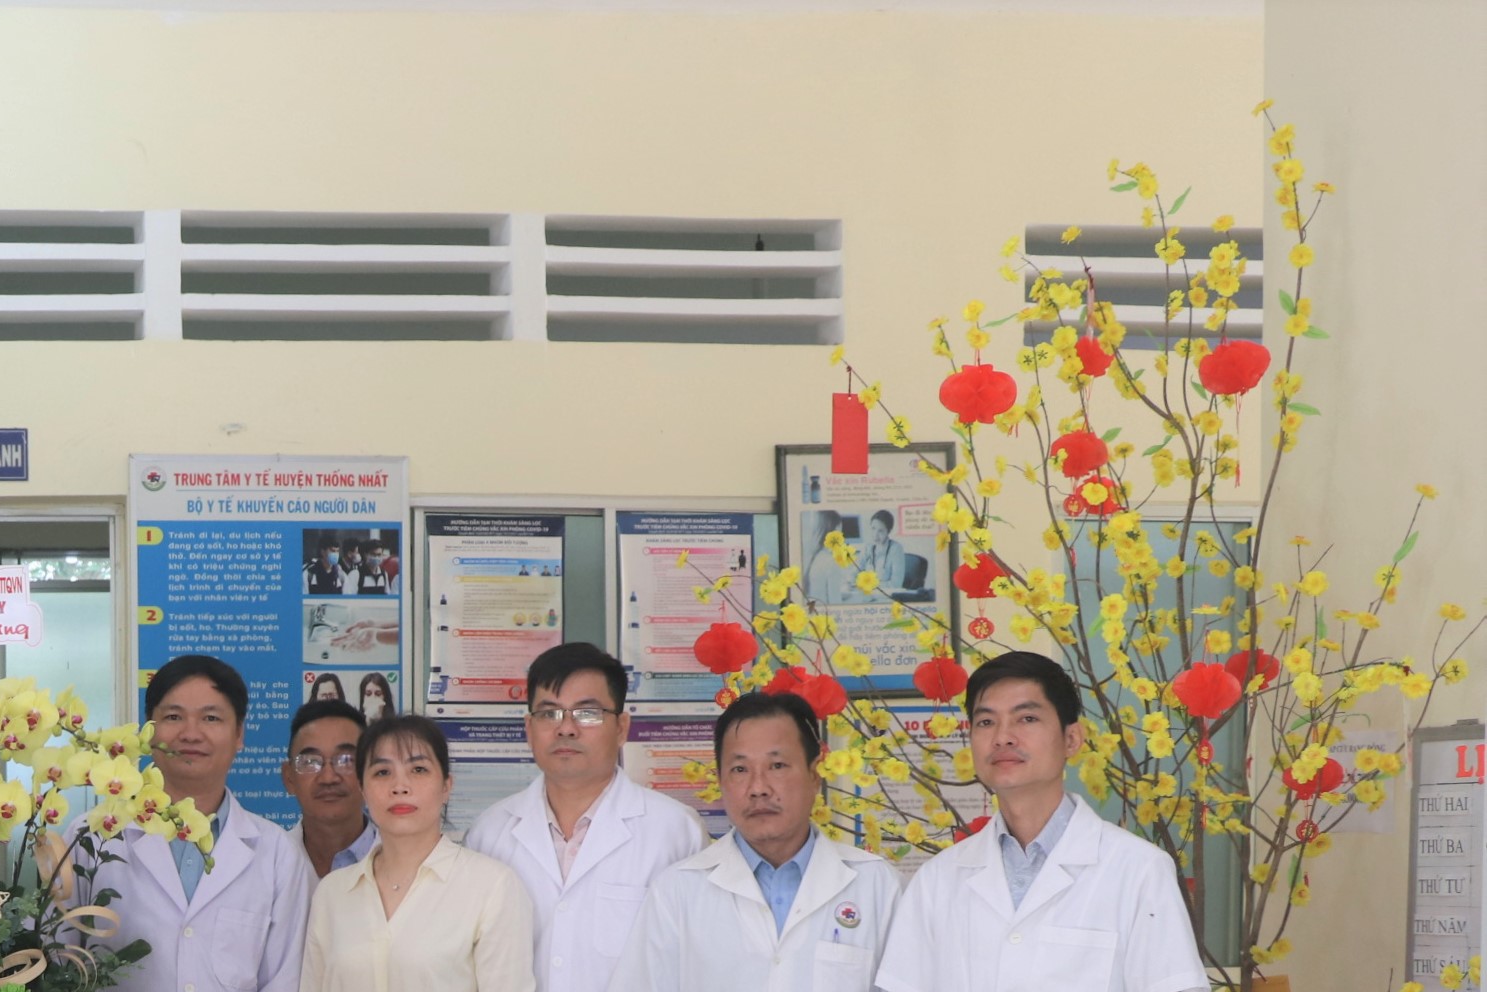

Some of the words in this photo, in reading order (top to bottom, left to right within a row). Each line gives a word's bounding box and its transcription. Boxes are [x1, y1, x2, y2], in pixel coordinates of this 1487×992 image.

[174, 473, 212, 486] TRUNG
[216, 470, 240, 486] TÂM
[245, 473, 251, 486] Y
[255, 468, 271, 486] TẾ
[274, 471, 312, 489] HUYỆN
[317, 469, 355, 487] THỐNG
[359, 469, 388, 487] NHẤT
[187, 497, 202, 516] BỘ
[208, 500, 214, 513] Y
[218, 495, 234, 513] TẾ
[237, 496, 283, 513] KHUYẾN
[287, 496, 310, 514] CÁO
[314, 497, 349, 514] NGƯỜI
[352, 497, 376, 513] DÂN
[146, 530, 151, 542] 1
[146, 610, 156, 621] 2
[904, 721, 919, 731] 10
[1419, 793, 1443, 812] THỨ
[1445, 796, 1470, 812] HAI
[1420, 835, 1443, 854] THỨ
[1446, 839, 1463, 853] BA
[1419, 874, 1443, 894] THỨ
[1447, 878, 1465, 894] TƯ
[1414, 916, 1436, 934] THỨ
[1414, 956, 1437, 974] THỨ
